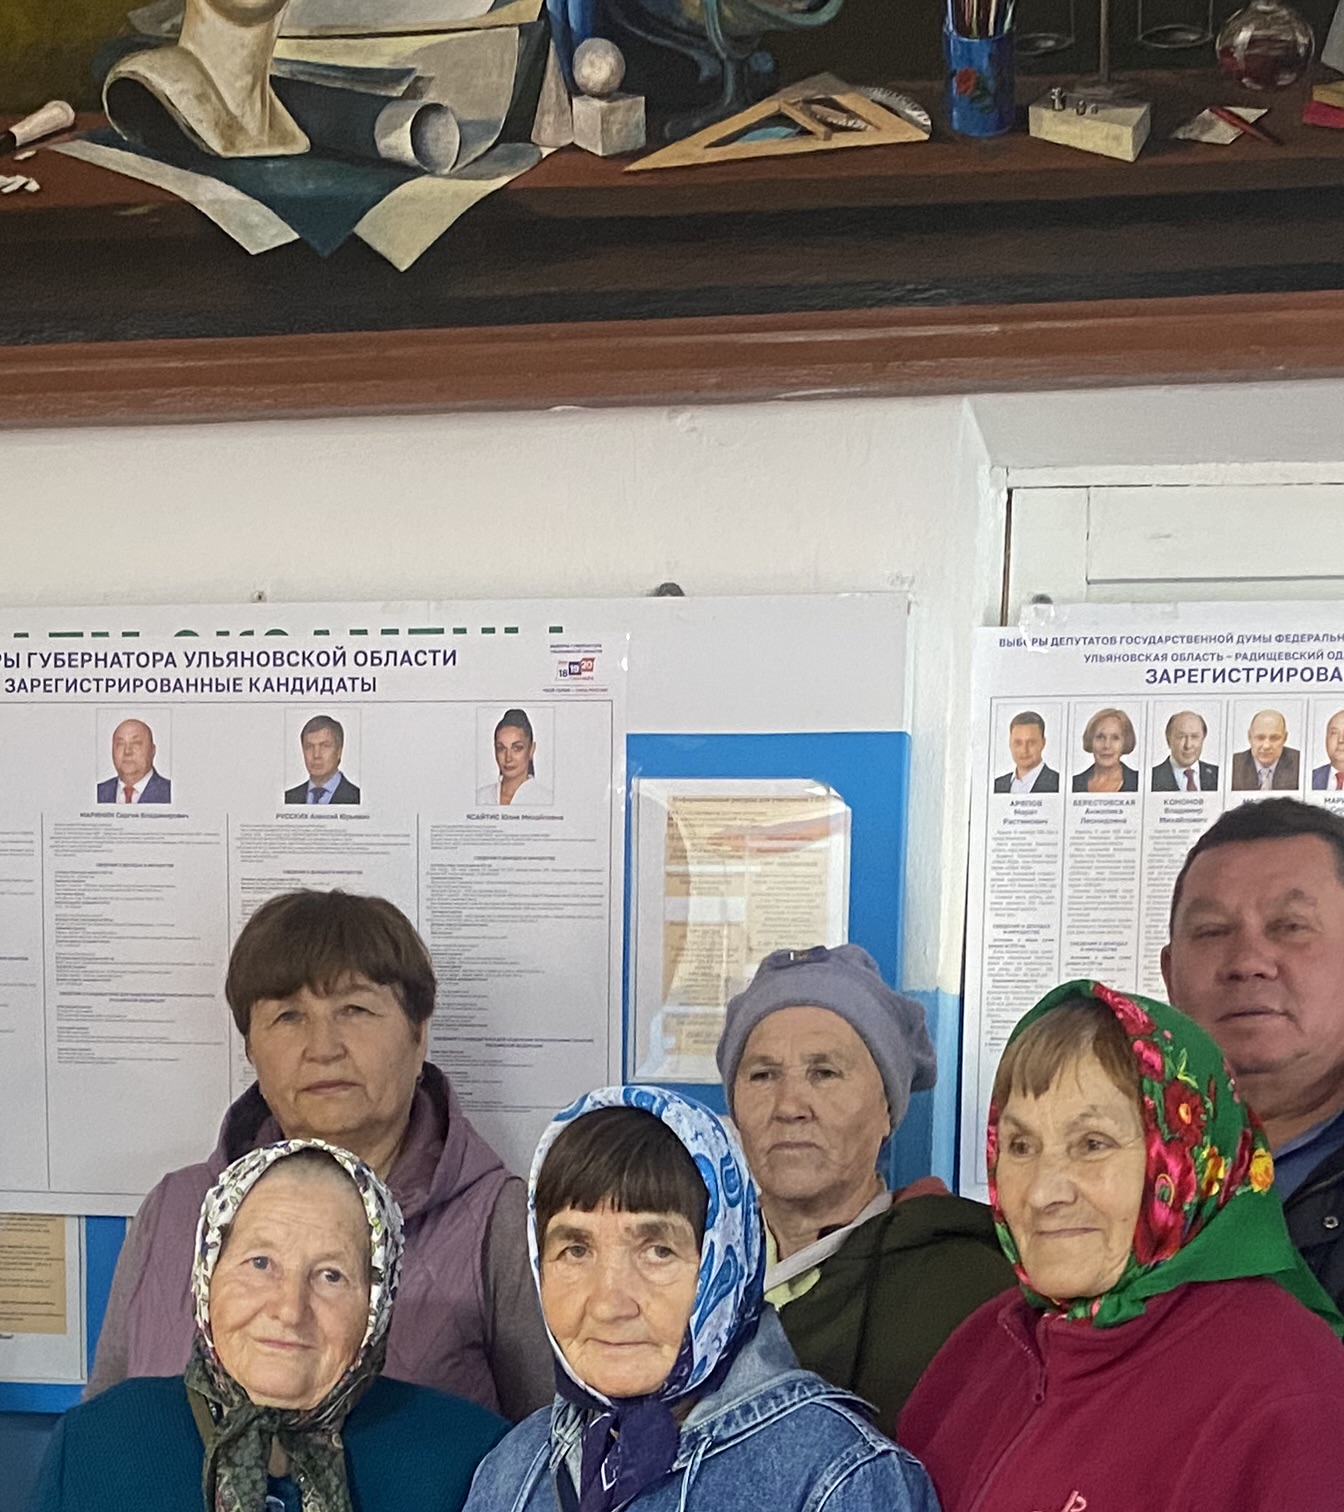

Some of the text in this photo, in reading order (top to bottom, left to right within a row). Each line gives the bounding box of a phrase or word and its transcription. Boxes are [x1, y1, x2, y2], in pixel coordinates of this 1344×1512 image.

[1050, 636, 1117, 646] ДЕПУТАТОВ
[1119, 633, 1234, 645] ГОСУДАРСТВЕННОЙ
[1236, 634, 1272, 645] ДУМЫ
[27, 651, 177, 669] ГУБЕРНАТОРА
[184, 646, 347, 668] УЛЬЯНОВСКОЙ
[354, 649, 457, 667] ОБЛАСТИ
[1084, 652, 1168, 663] УЛЬЯНОВСКАЯ
[1171, 652, 1224, 662] ОБЛАСТЬ
[1235, 649, 1324, 662] РАДИЩЕВСКИЙ
[559, 669, 568, 677] 18
[5, 676, 376, 694] ЗАРЕГИСТРИРОВАННЫЕ КАНДИДАТЫ
